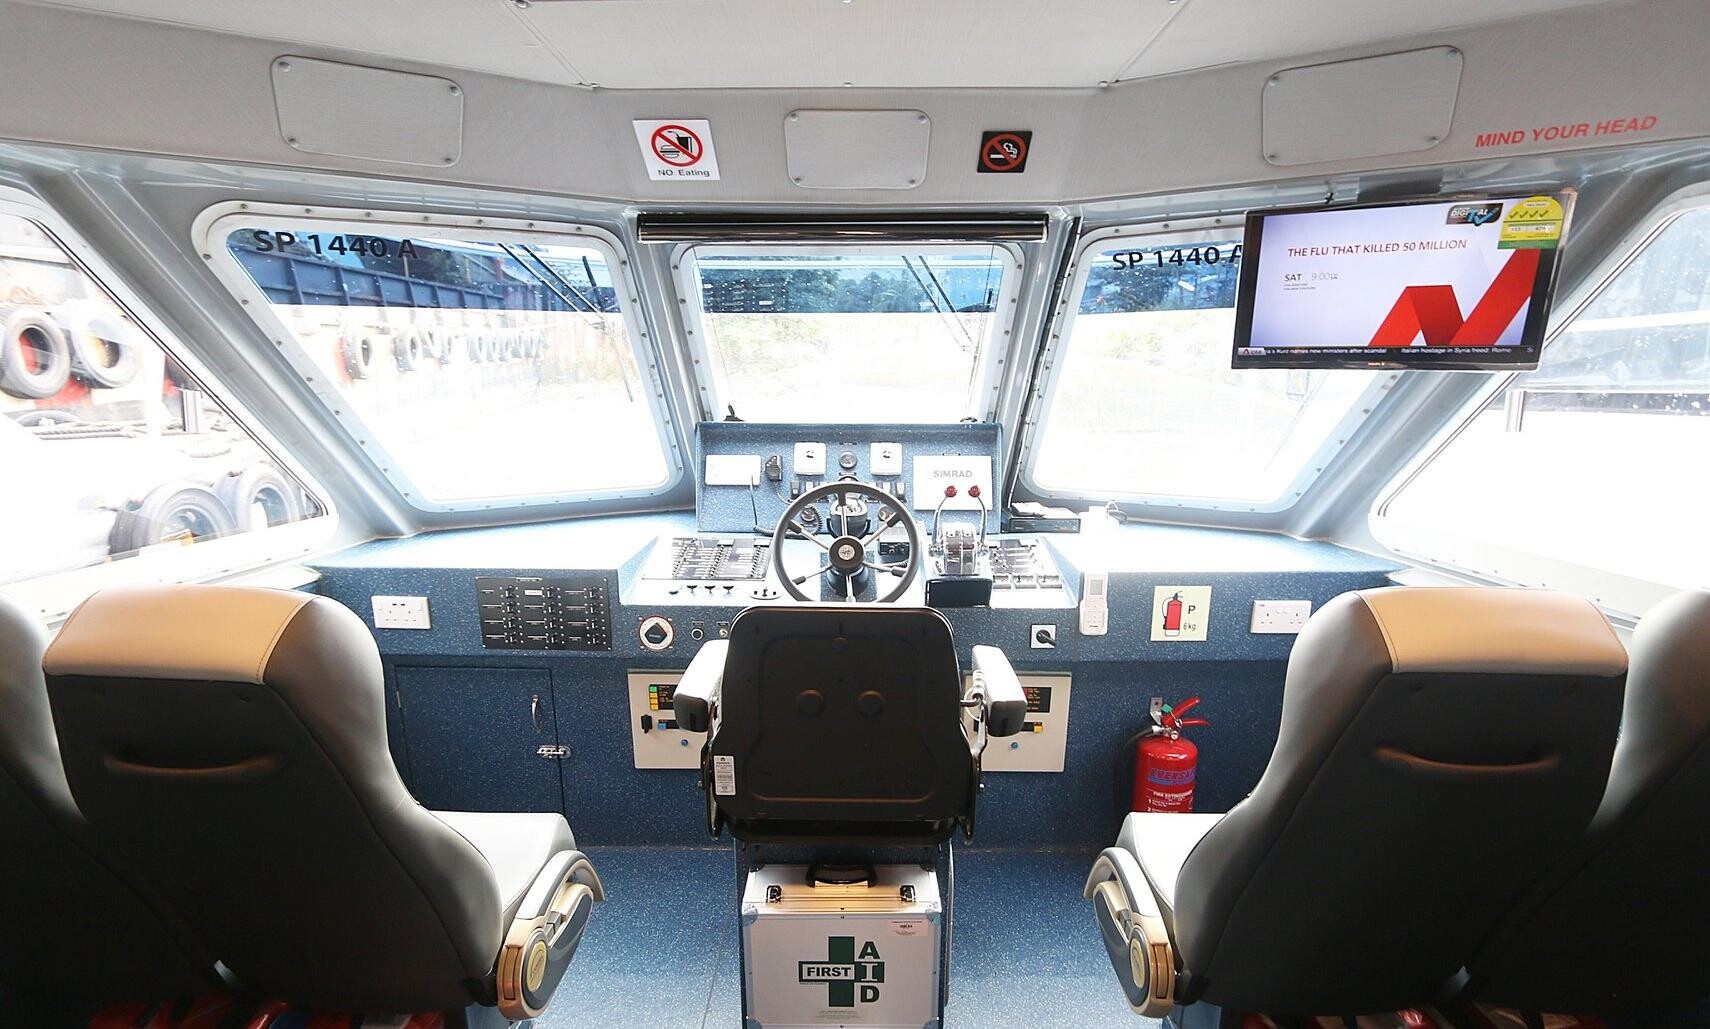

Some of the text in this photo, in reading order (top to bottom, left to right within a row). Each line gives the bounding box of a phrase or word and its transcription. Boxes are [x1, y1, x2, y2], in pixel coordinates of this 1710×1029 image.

[1474, 115, 1658, 147] MIND YOUR HEAD
[678, 169, 710, 177] Eating
[252, 230, 418, 260] SP 1440 A
[1288, 239, 1467, 257] THE FLU THAT KILLED 50 MILLION
[1112, 251, 1143, 271] SP
[1153, 246, 1220, 268] 1440
[932, 470, 973, 478] SIMRAD
[1188, 605, 1196, 615] P
[807, 966, 852, 978] FIRST
[858, 941, 880, 1003] AID
